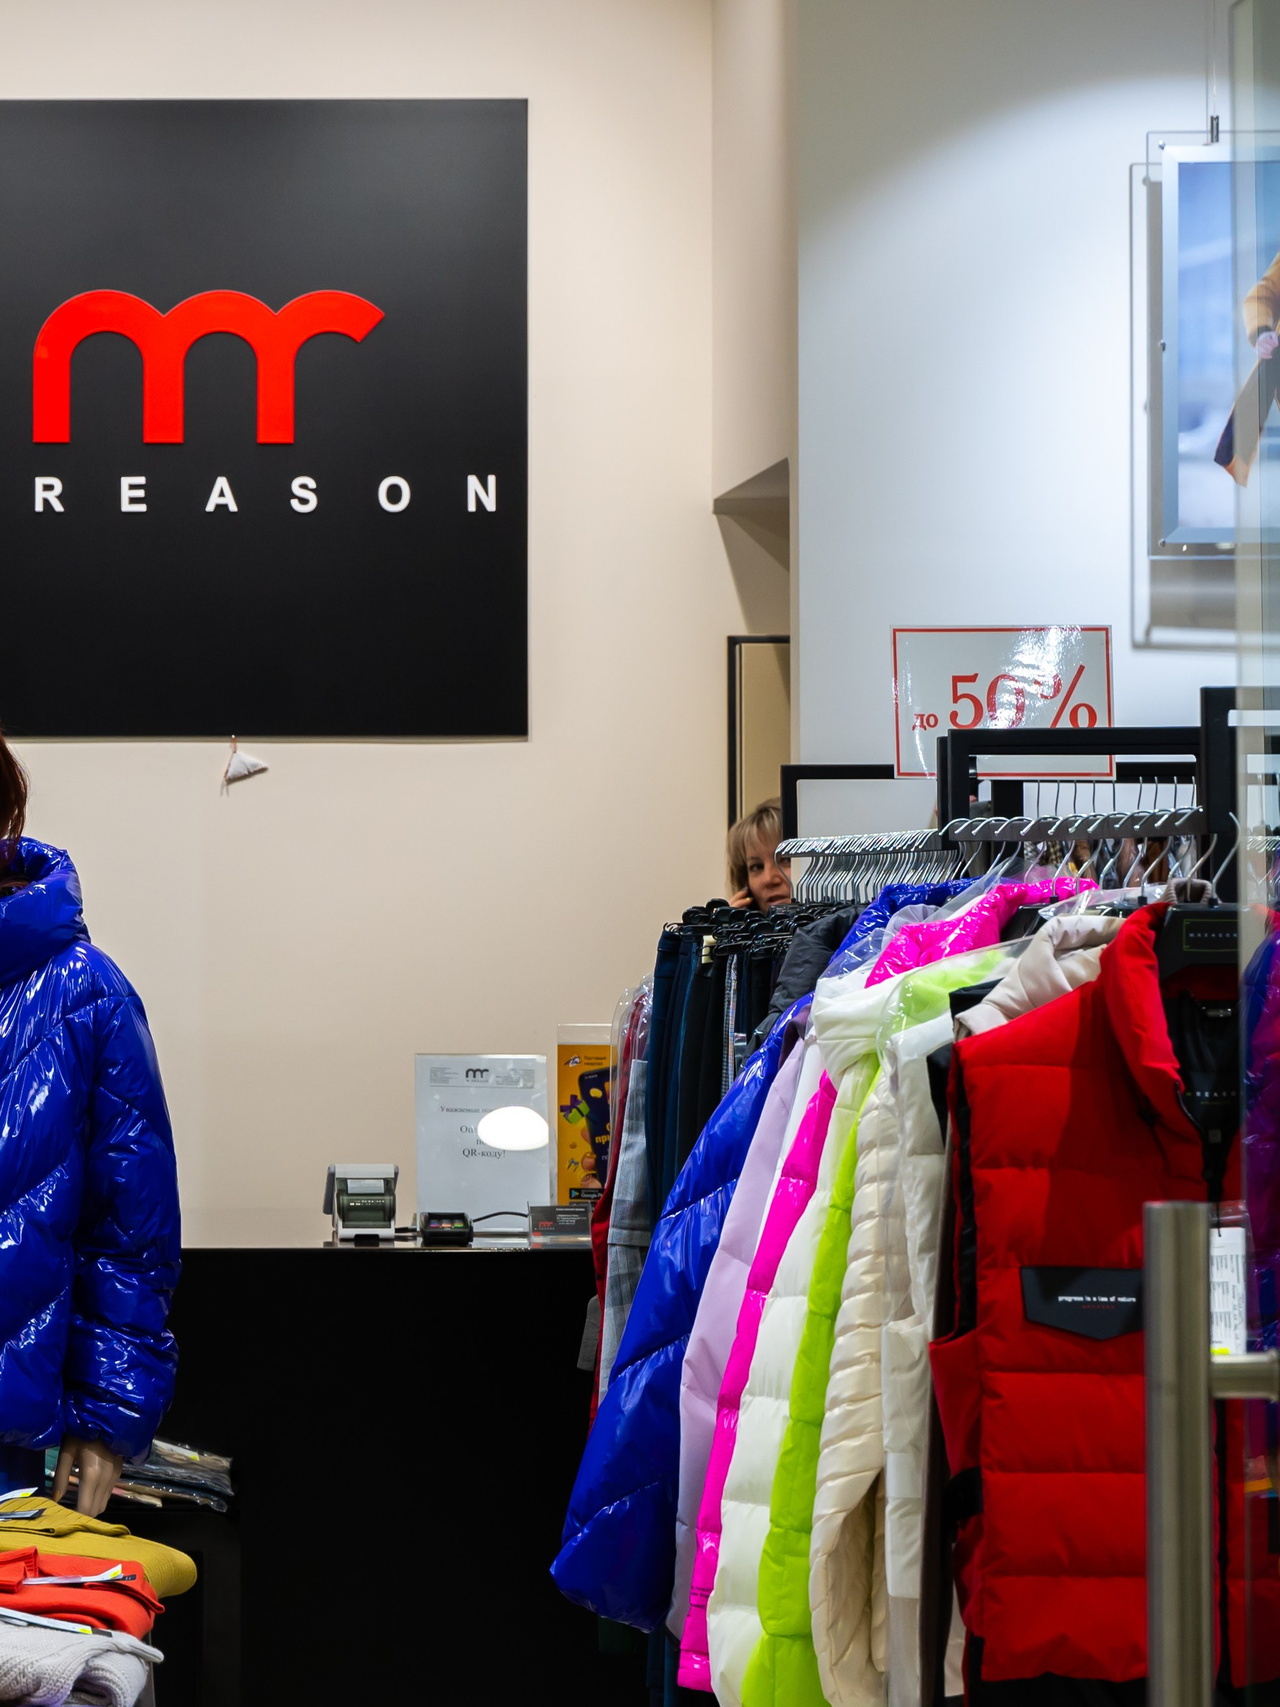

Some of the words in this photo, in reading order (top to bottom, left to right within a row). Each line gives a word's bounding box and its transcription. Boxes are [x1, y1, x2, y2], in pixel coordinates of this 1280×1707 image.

[33, 474, 498, 514] REASON
[911, 713, 939, 731] до
[949, 664, 1098, 729] 50%
[462, 1148, 506, 1159] QR-коду!
